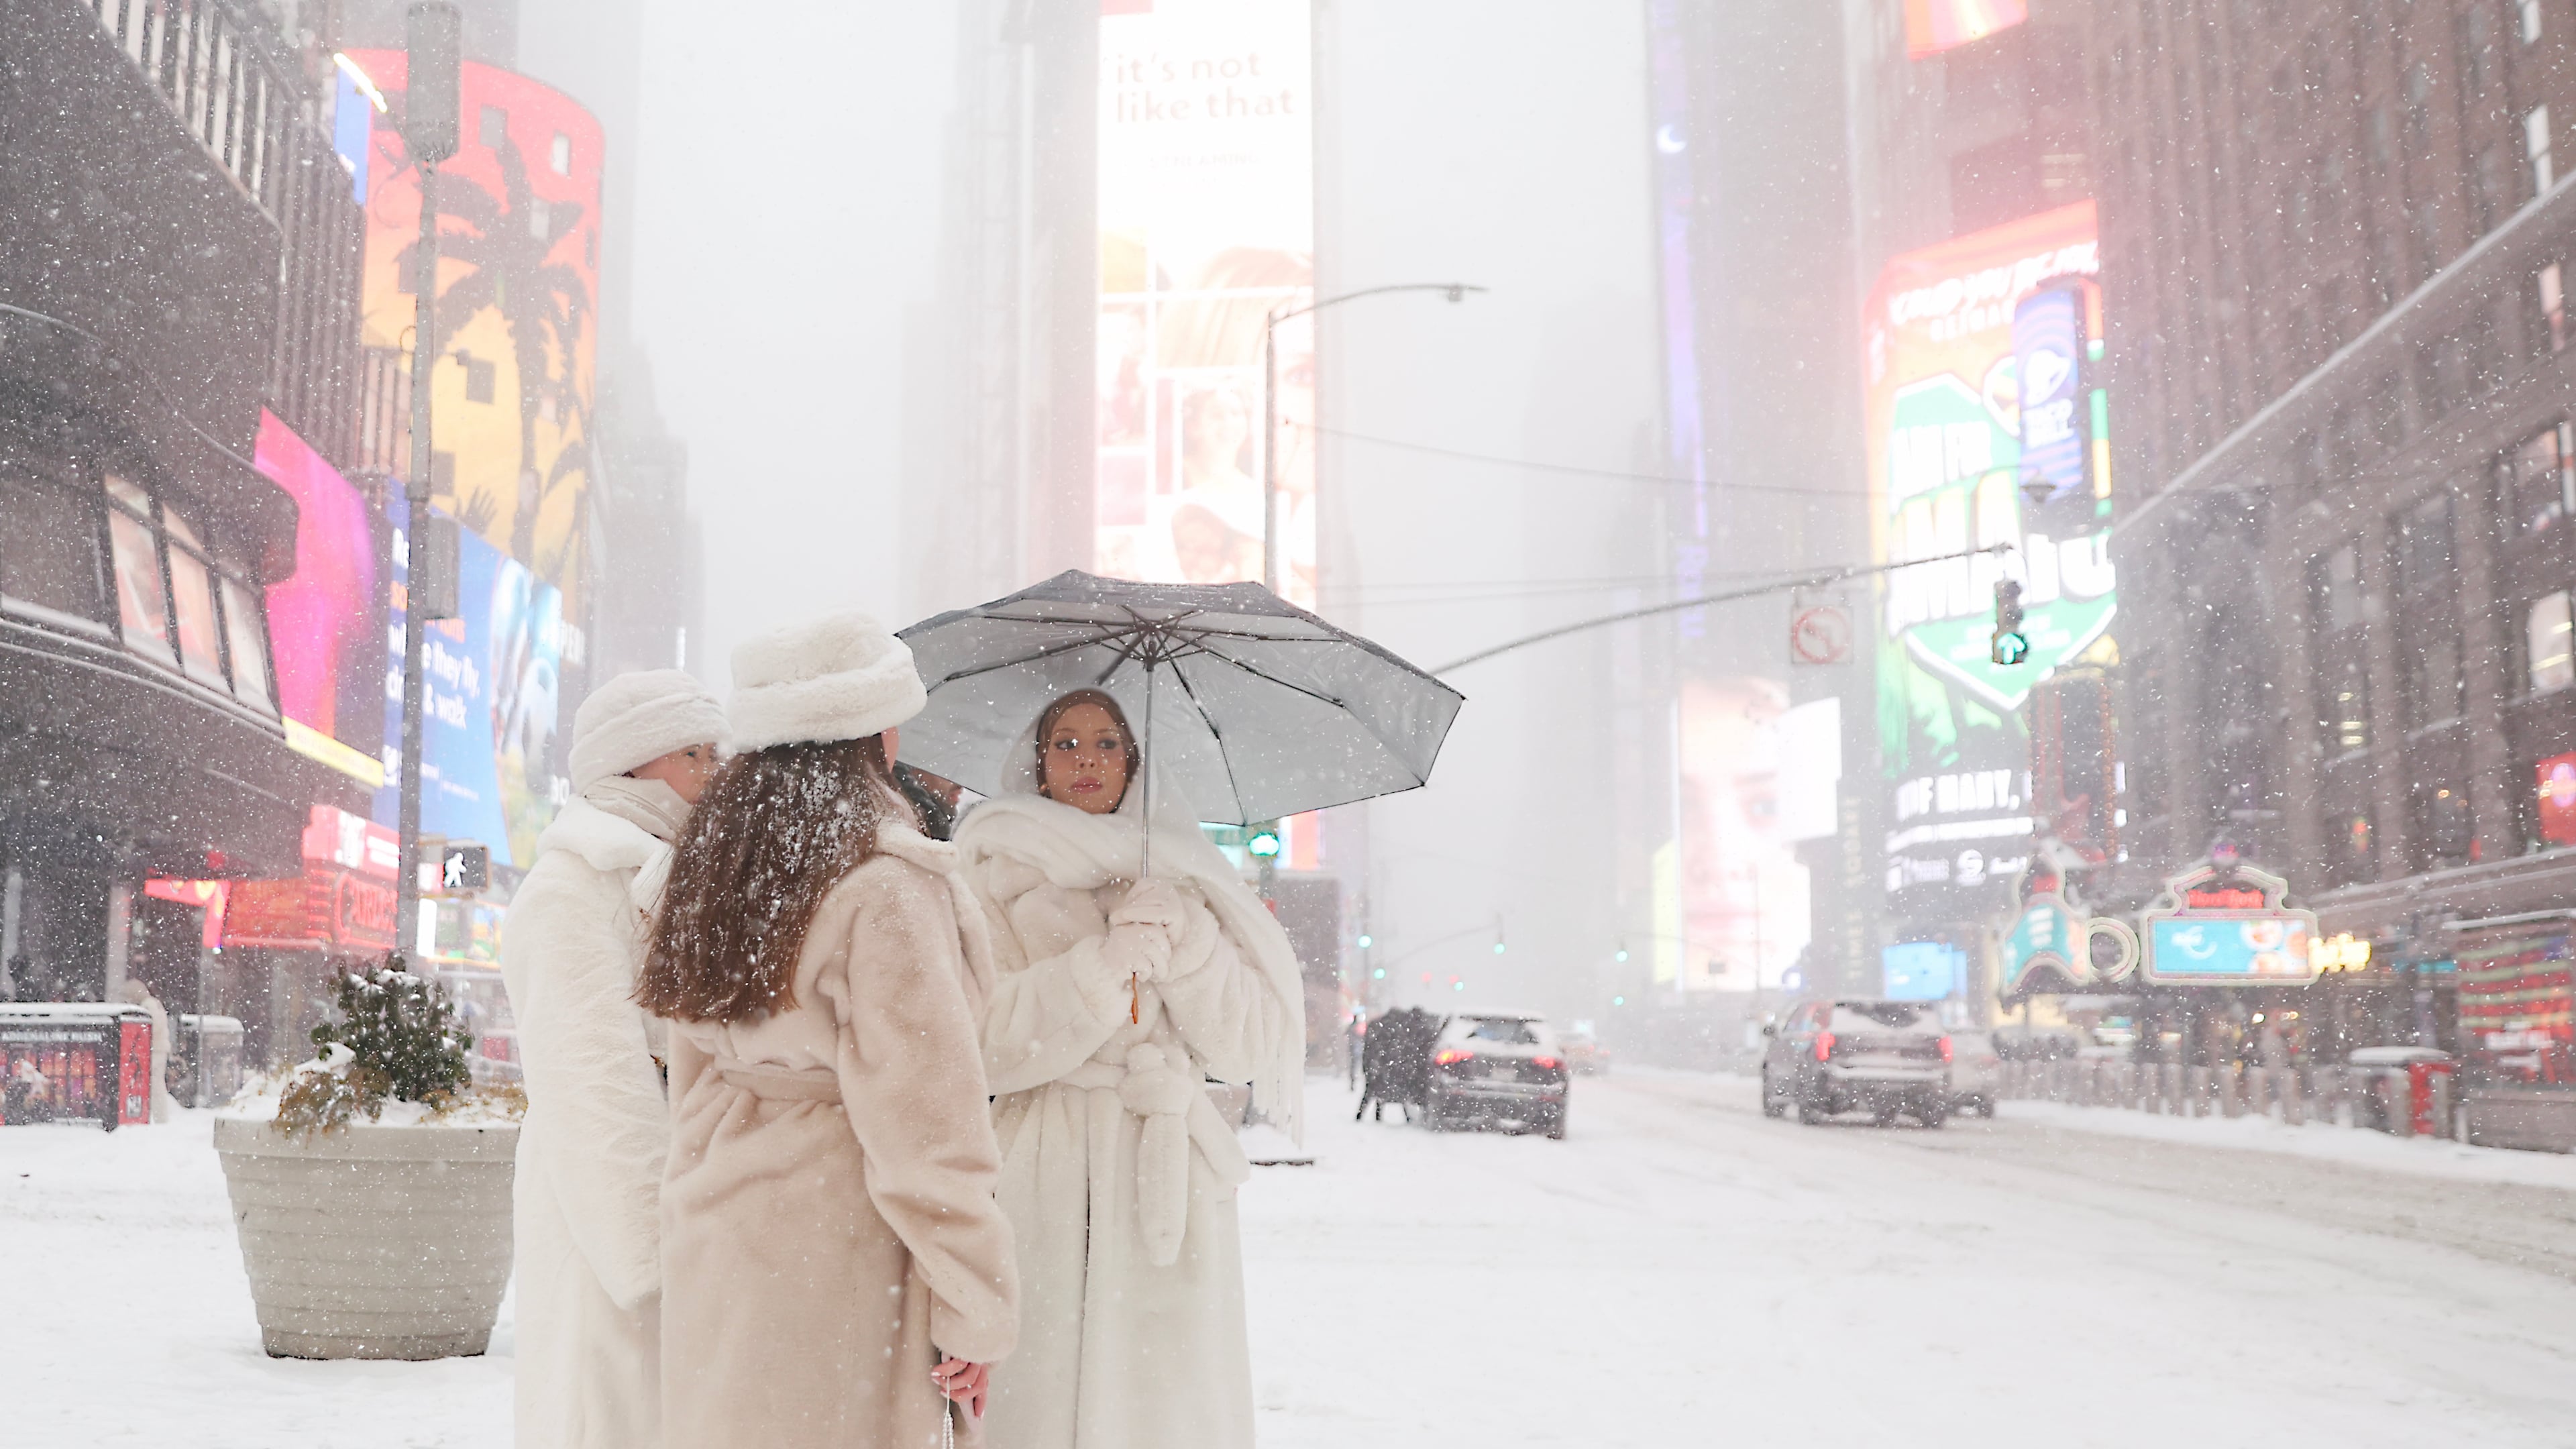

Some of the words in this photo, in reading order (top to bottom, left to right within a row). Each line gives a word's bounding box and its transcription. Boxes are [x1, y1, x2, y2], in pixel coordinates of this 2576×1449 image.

[1117, 52, 1175, 83] it's
[1191, 52, 1261, 79] not
[1117, 90, 1190, 123] like
[1206, 85, 1293, 118] that
[433, 641, 462, 692] they
[436, 693, 467, 730] walk
